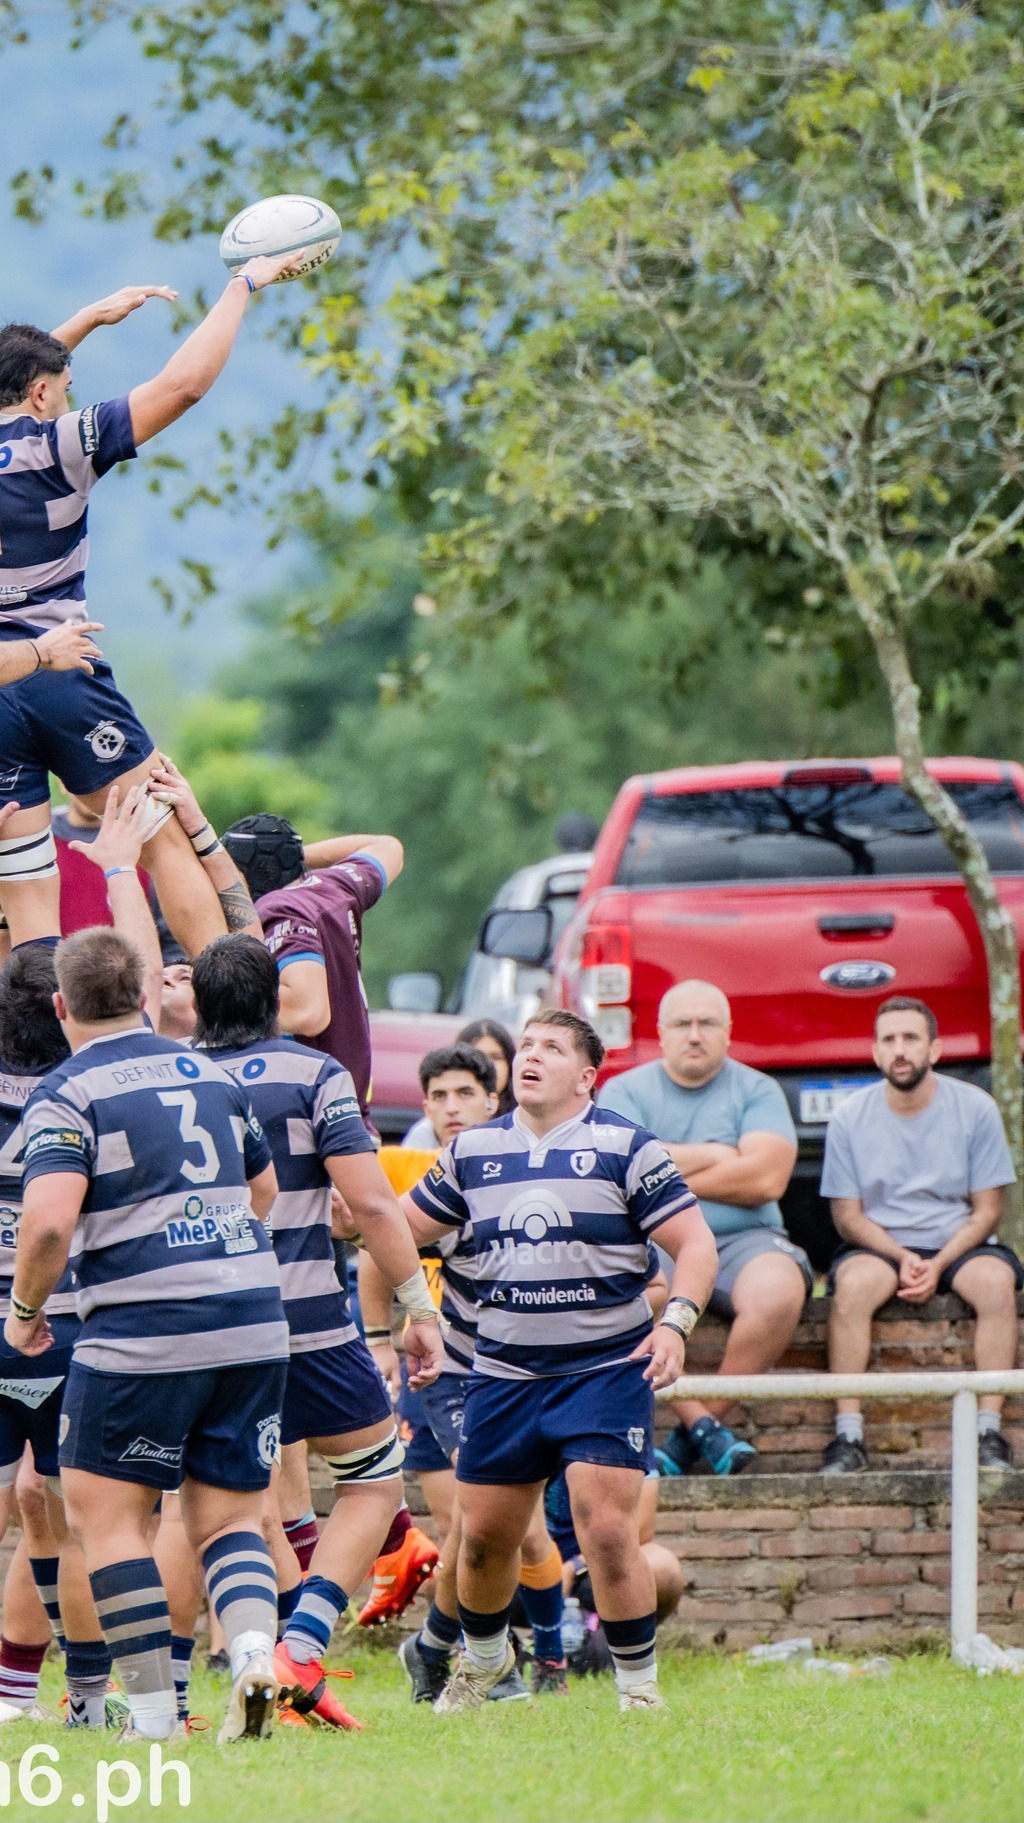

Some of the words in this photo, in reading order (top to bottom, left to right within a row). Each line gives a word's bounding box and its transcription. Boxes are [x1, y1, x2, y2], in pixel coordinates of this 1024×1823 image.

[273, 245, 333, 281] BERT
[156, 1089, 221, 1184] 3
[489, 1238, 588, 1266] Macro
[510, 1283, 596, 1305] Providencia
